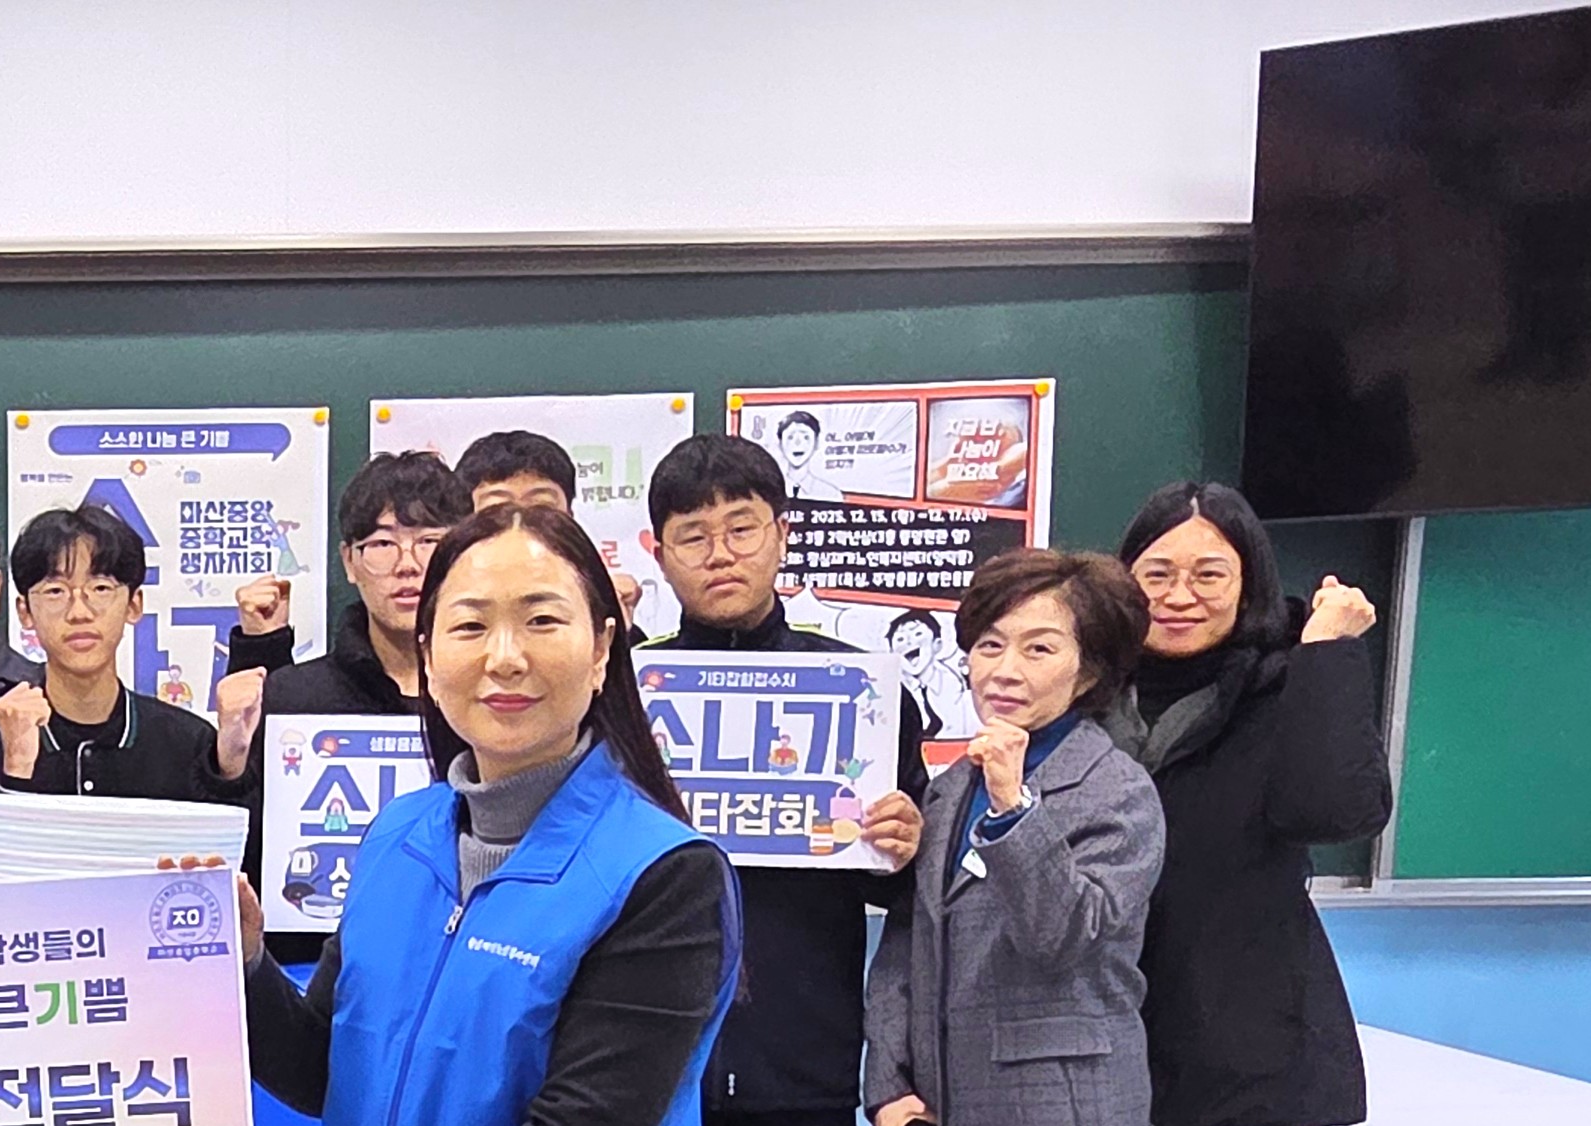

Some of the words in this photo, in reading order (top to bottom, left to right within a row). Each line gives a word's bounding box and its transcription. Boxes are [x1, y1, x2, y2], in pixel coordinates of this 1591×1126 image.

[98, 431, 143, 449] 소소한
[147, 431, 177, 449] 나눔
[200, 430, 230, 448] 기쁨
[180, 501, 273, 523] 마산중앙
[180, 526, 272, 549] 중학교학
[180, 551, 271, 574] 생자치회
